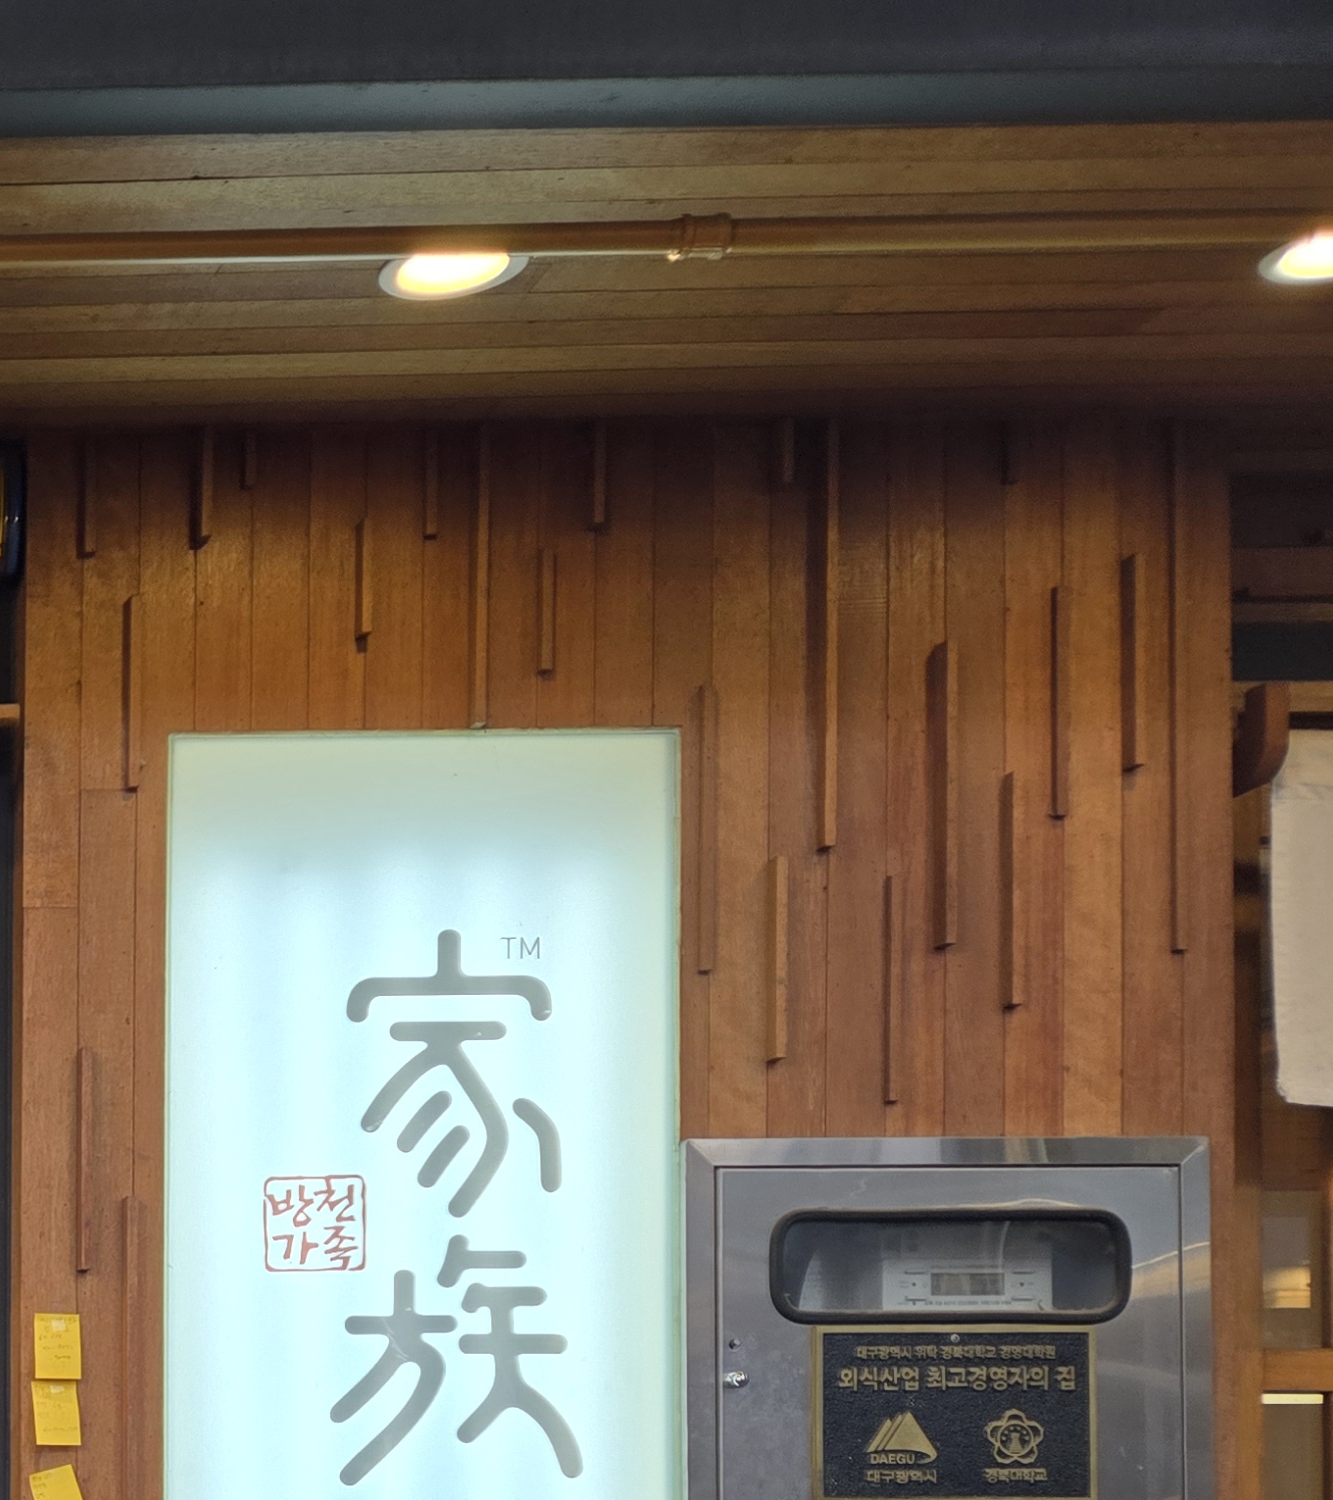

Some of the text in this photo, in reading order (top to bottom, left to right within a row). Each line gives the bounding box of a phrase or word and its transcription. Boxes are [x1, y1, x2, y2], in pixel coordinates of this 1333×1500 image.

[330, 929, 583, 1486] 家族
[838, 1365, 1076, 1392] 외식산업 최고경영자의 집
[869, 1453, 916, 1465] DAEGU
